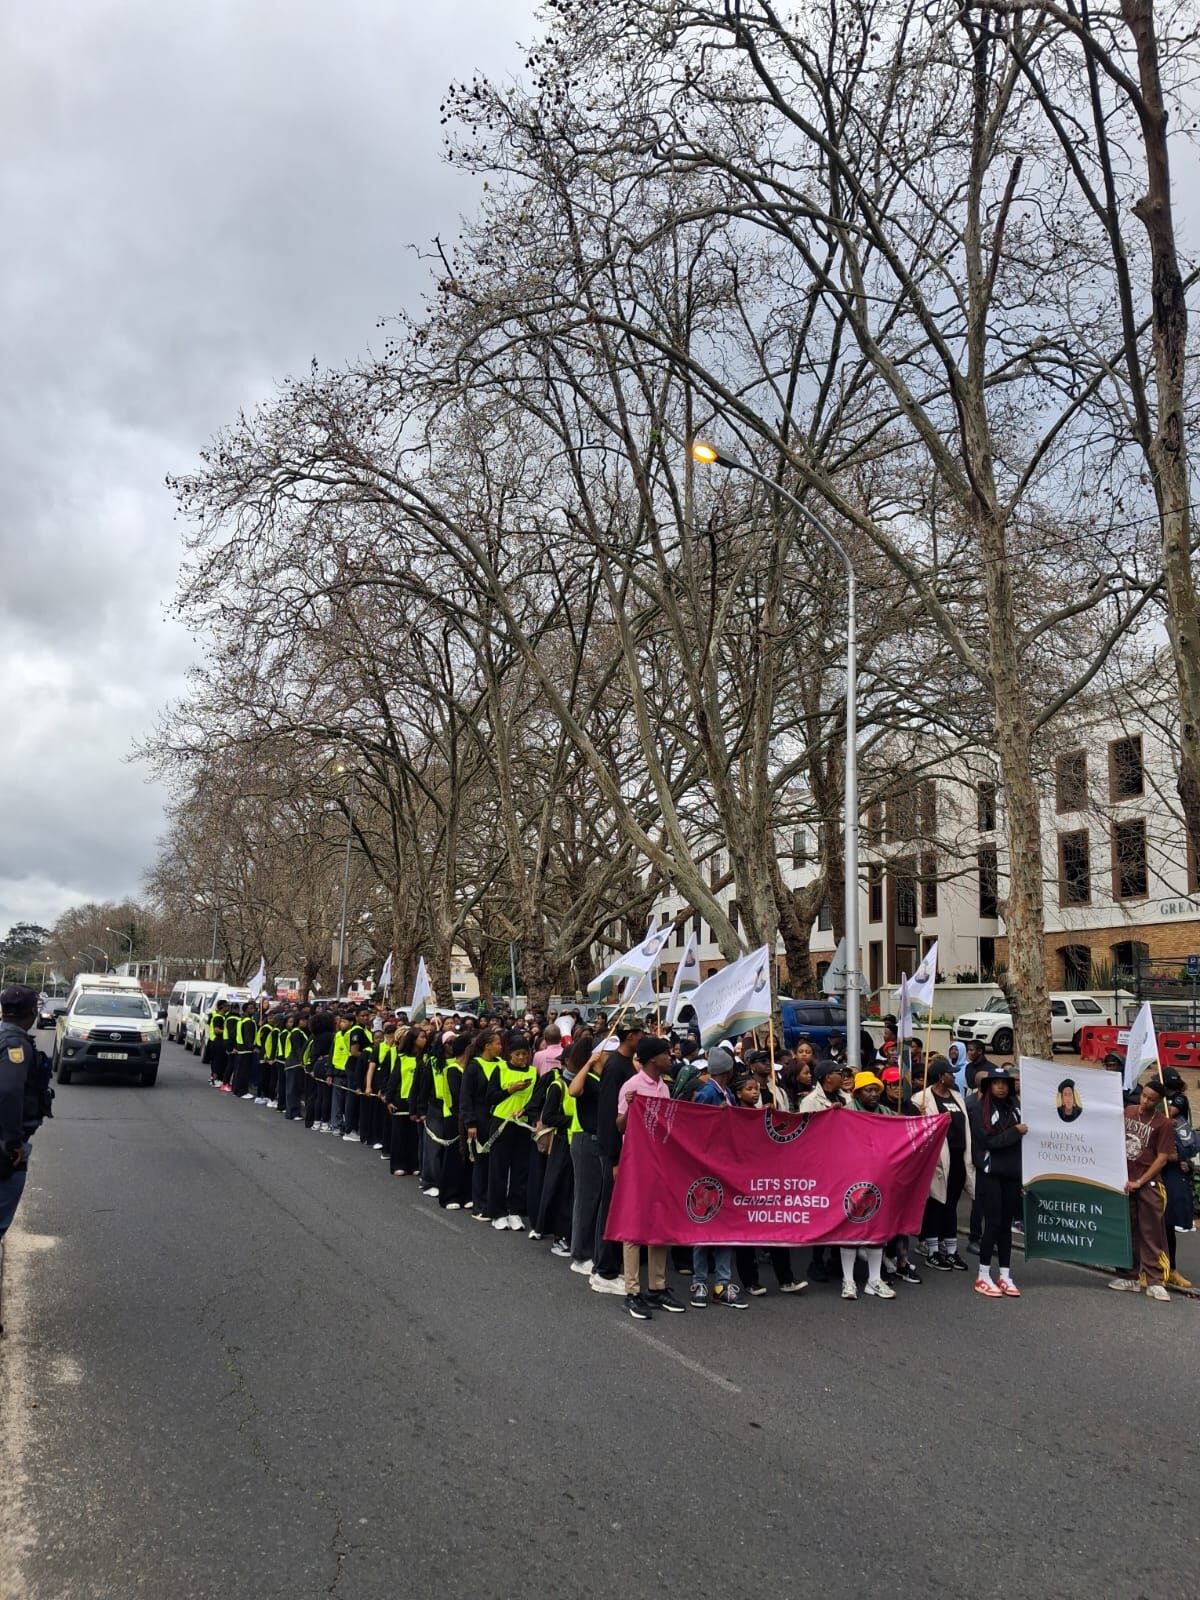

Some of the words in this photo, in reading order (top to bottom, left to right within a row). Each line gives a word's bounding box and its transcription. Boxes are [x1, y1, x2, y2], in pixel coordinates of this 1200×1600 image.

[1038, 1151, 1096, 1165] FOUNDATION
[750, 1179, 780, 1191] LET'S
[783, 1179, 816, 1191] STOP
[733, 1195, 781, 1206] GENDER
[784, 1195, 830, 1208] BASED
[1090, 1204, 1103, 1215] IN
[747, 1210, 810, 1224] VIOLENCE
[1037, 1231, 1094, 1248] HUMANITY
